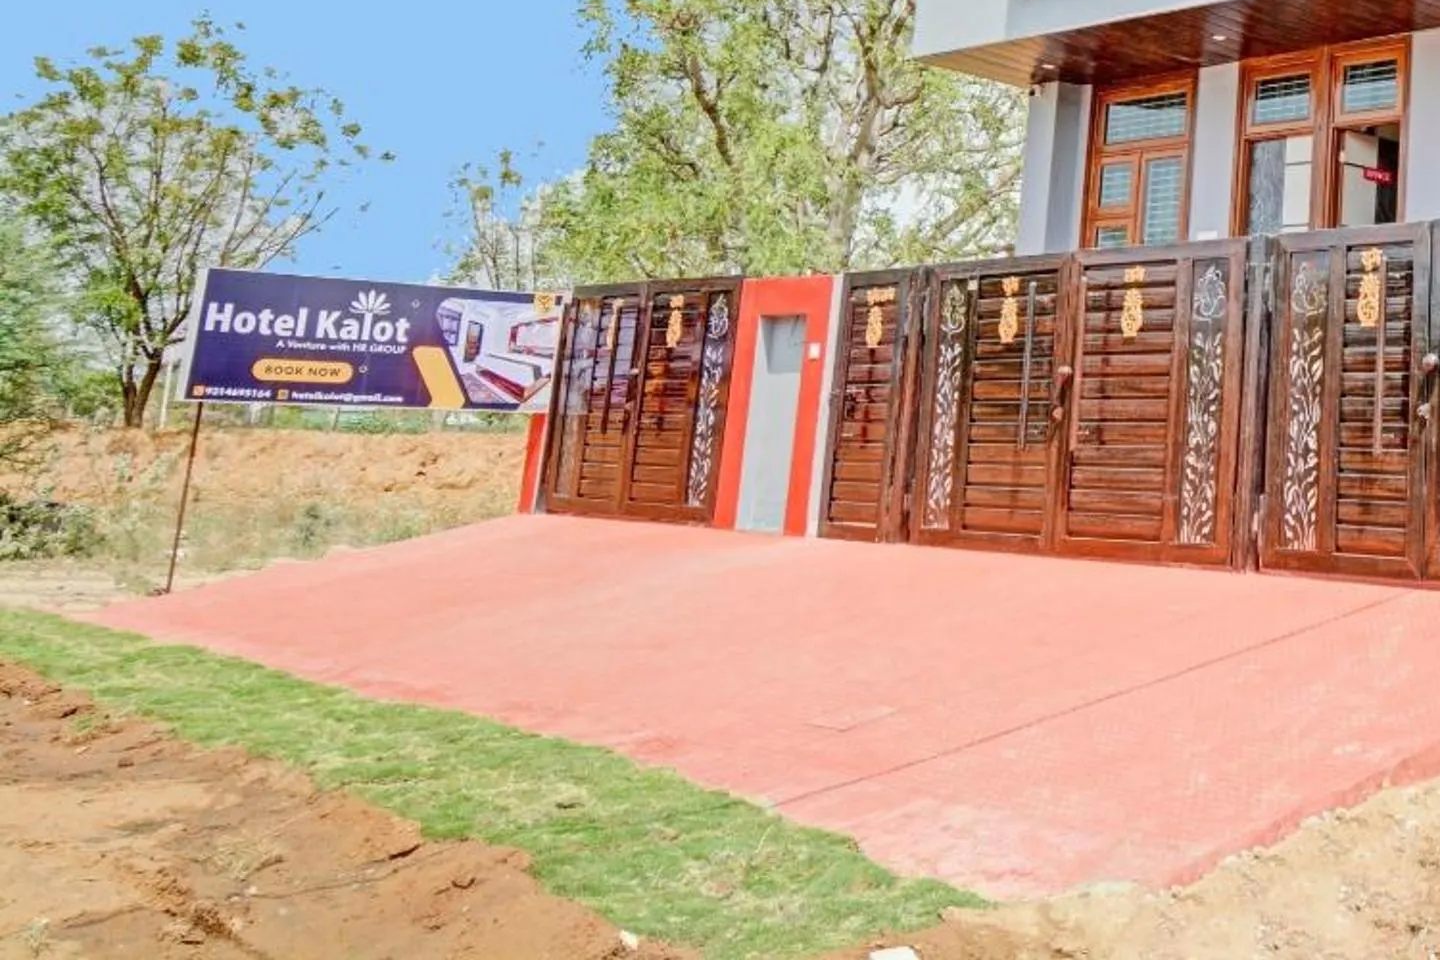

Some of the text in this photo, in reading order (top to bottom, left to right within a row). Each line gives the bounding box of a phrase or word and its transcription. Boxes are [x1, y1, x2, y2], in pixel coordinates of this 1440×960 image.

[204, 302, 411, 343] Hotel Kalot
[275, 340, 286, 349] A
[287, 340, 327, 351] Venture
[328, 342, 351, 352] with
[370, 344, 407, 354] GROUP
[264, 364, 342, 378] BOOK NOW
